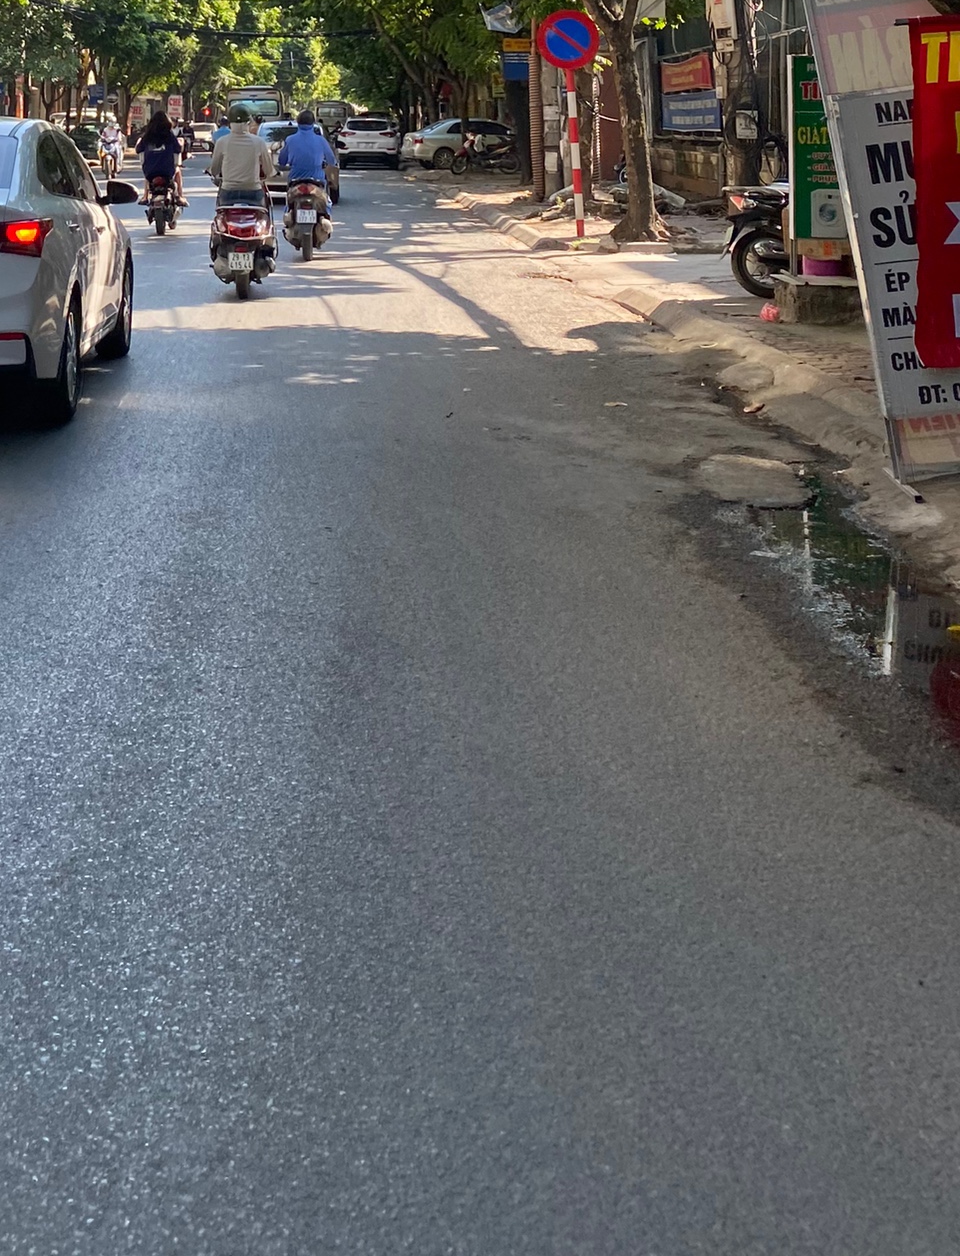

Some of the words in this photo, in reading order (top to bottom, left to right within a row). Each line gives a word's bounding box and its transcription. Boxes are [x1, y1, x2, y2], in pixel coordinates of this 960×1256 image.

[884, 269, 911, 293] ÉP
[881, 302, 916, 328] MÀ
[918, 384, 948, 405] ĐT:
